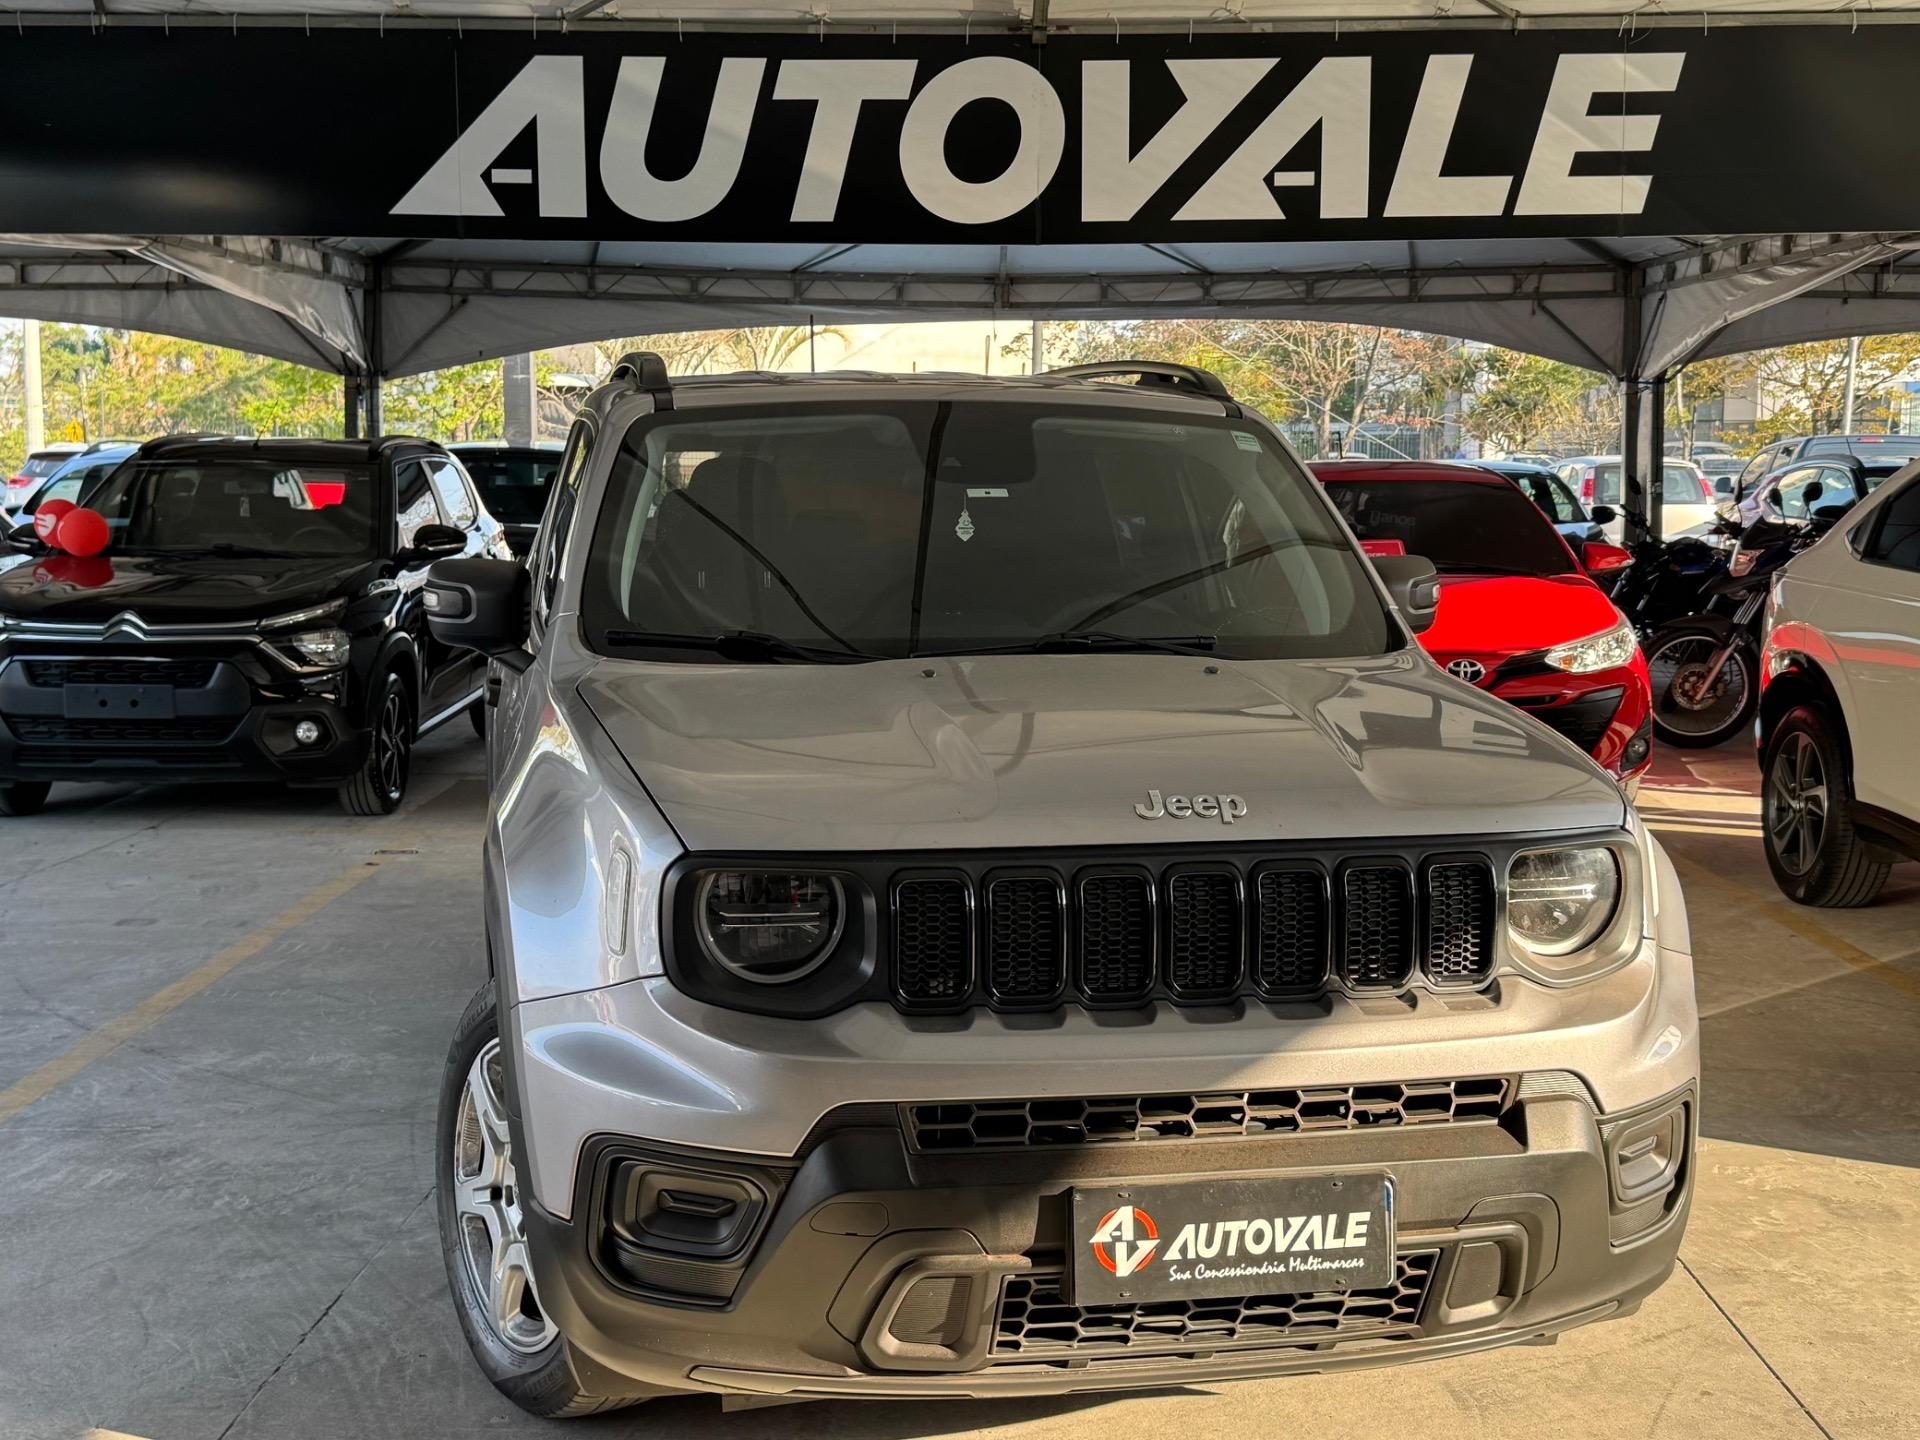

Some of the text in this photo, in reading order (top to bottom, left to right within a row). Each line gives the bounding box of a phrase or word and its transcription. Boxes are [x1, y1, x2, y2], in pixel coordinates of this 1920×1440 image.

[389, 52, 1687, 224] AUTOVALE
[1134, 789, 1248, 824] Jeep
[1163, 1211, 1371, 1261] AUTOVALE
[1169, 1264, 1192, 1282] Sua
[1288, 1255, 1366, 1273] Multimarcas
